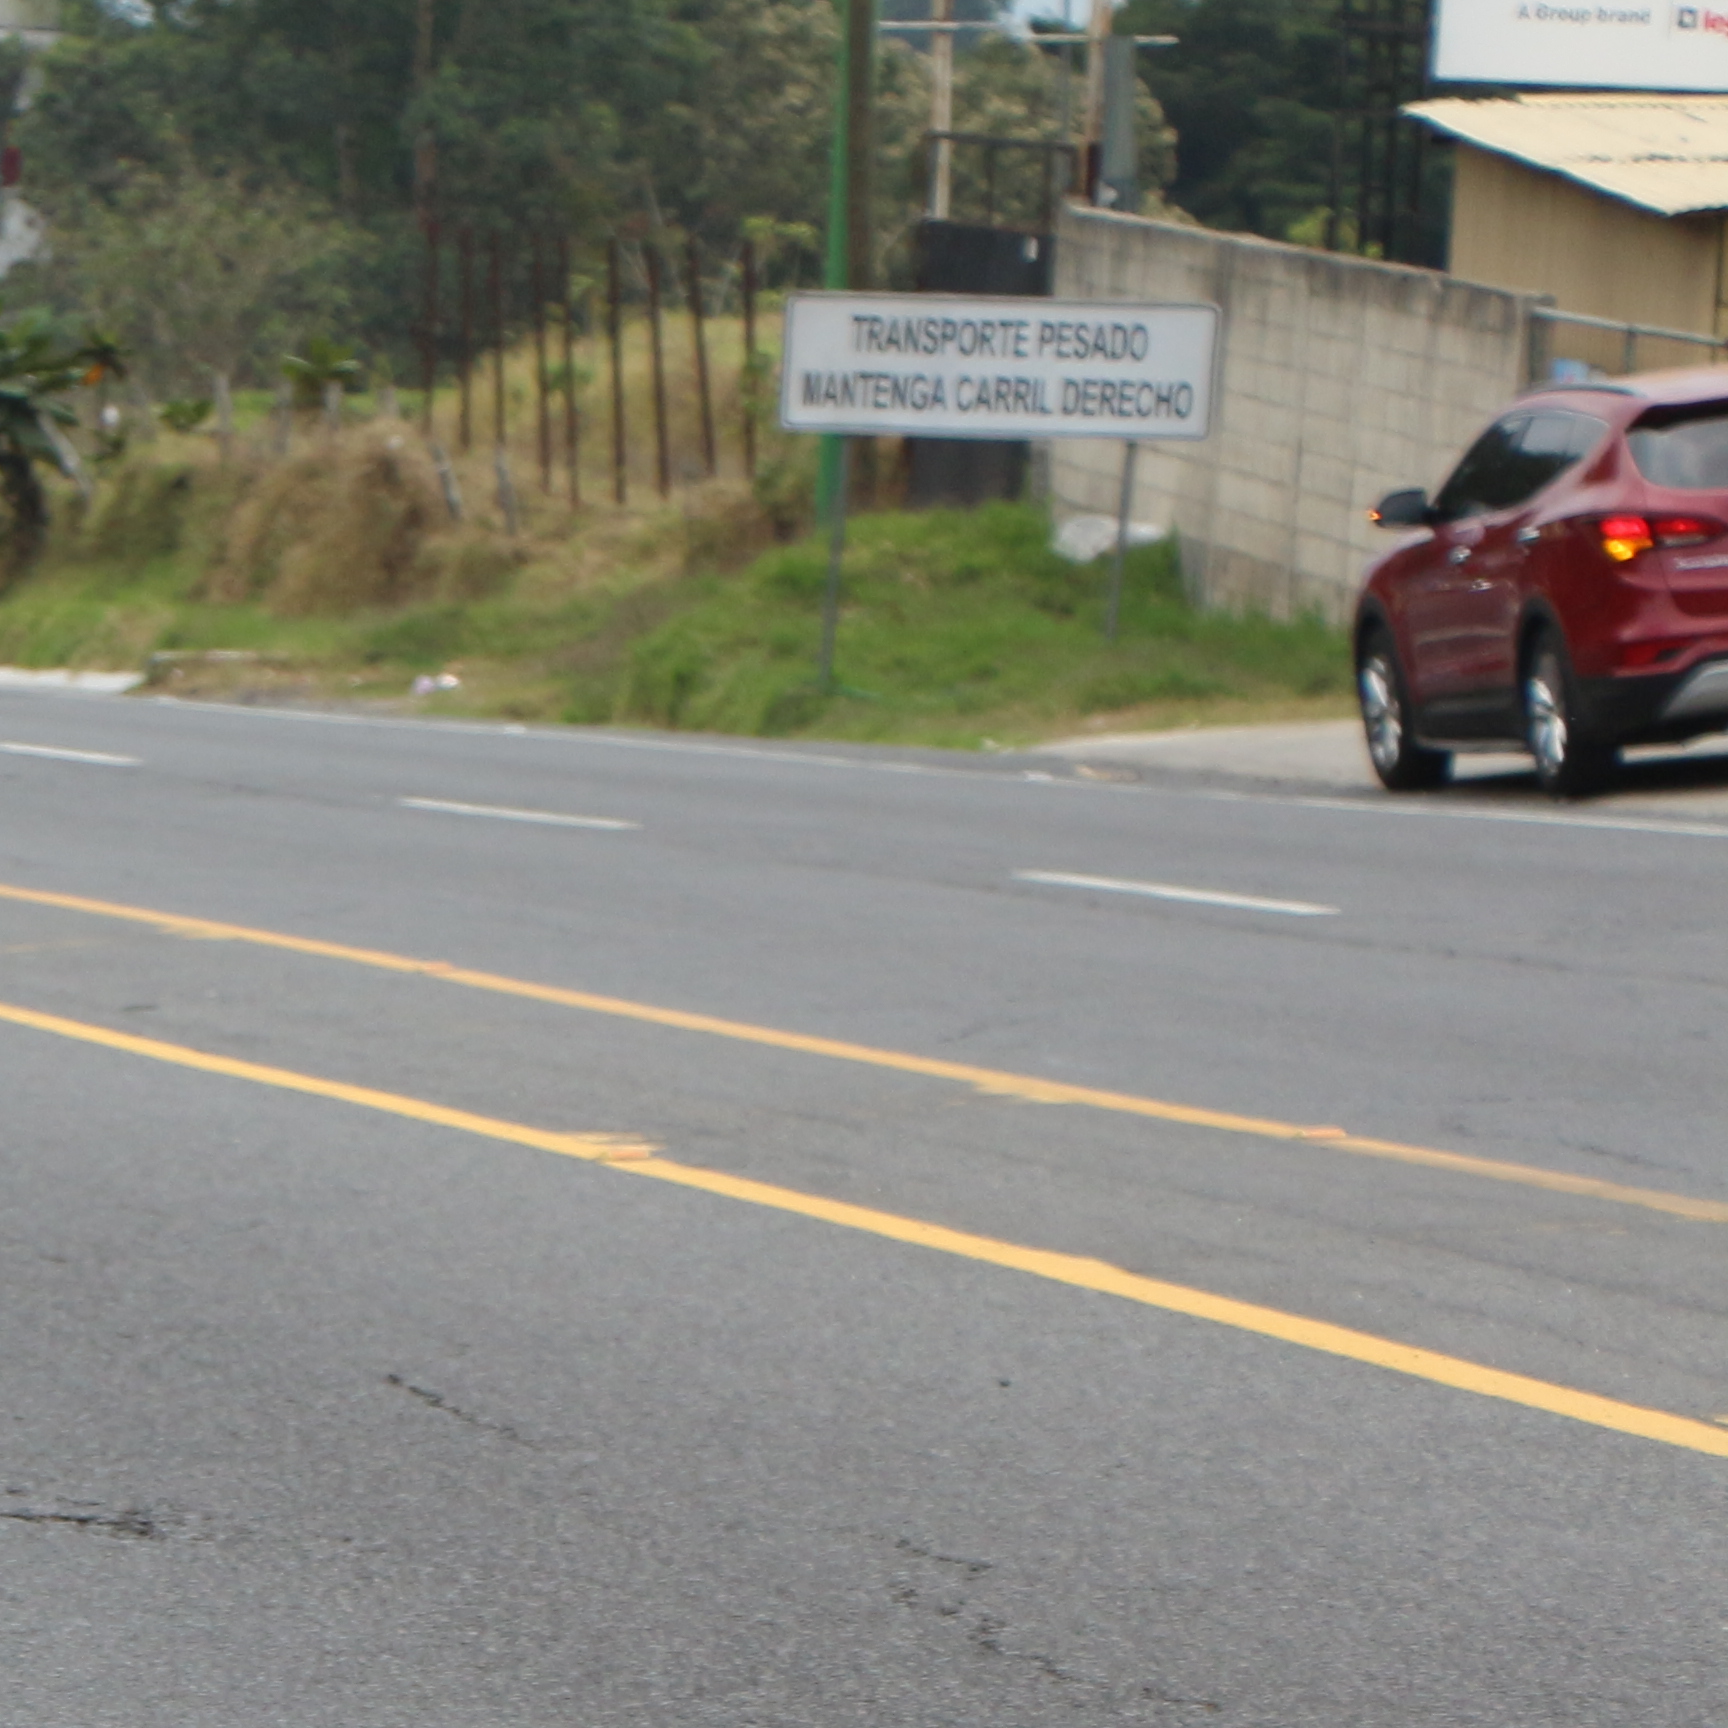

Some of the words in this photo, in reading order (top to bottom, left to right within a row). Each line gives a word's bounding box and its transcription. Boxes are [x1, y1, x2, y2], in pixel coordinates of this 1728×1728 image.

[1536, 4, 1592, 25] Group
[1597, 7, 1650, 24] brand
[852, 314, 1030, 358] TRANSPORTE
[1038, 321, 1150, 361] PESADO
[802, 370, 946, 412] MANTENGA
[956, 375, 1053, 415] CARRIL
[1062, 377, 1194, 419] DERECHO
